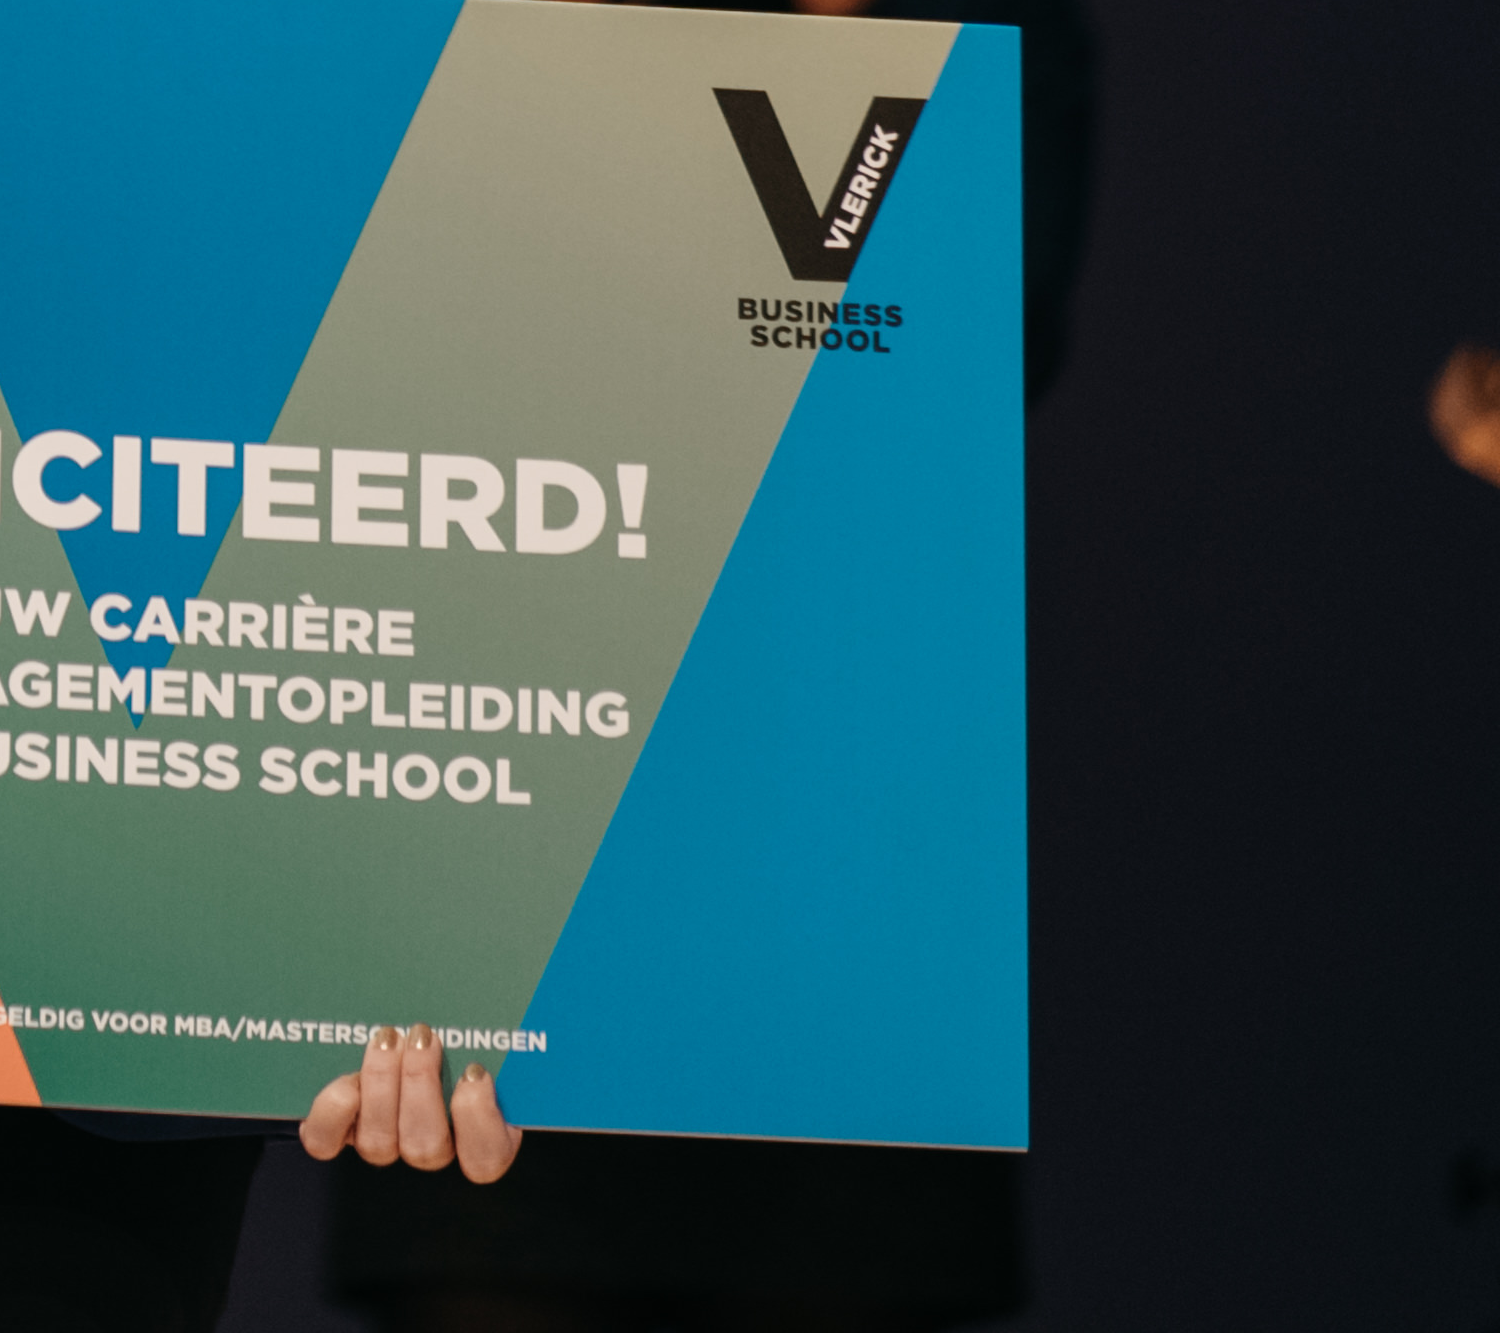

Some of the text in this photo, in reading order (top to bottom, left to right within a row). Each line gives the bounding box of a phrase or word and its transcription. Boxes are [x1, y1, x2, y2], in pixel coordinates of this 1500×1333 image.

[823, 123, 900, 250] VLERICK
[737, 296, 904, 328] BUSINESS
[750, 324, 892, 354] SCHOOL
[89, 592, 416, 657] CARRIÈRE
[258, 745, 532, 806] SCHOOL
[91, 1009, 168, 1036] VOOR
